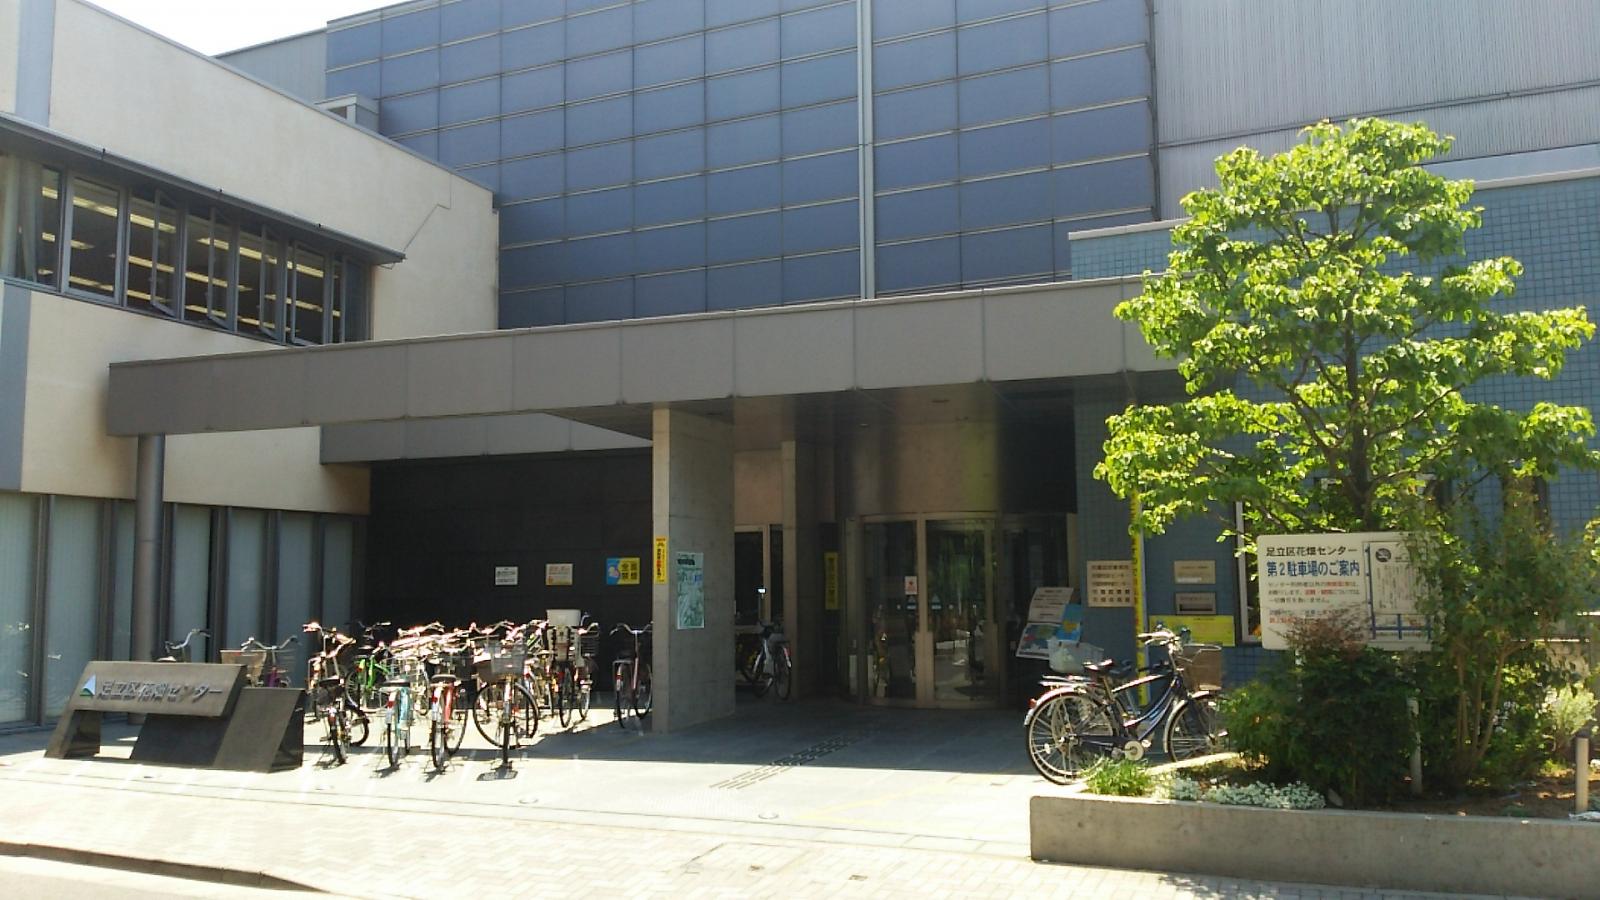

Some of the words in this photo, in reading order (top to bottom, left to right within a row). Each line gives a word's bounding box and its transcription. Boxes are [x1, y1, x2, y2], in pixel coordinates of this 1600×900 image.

[1266, 546, 1358, 557] 足立区花畑センター
[1267, 560, 1360, 577] 第2駐車場のご案内
